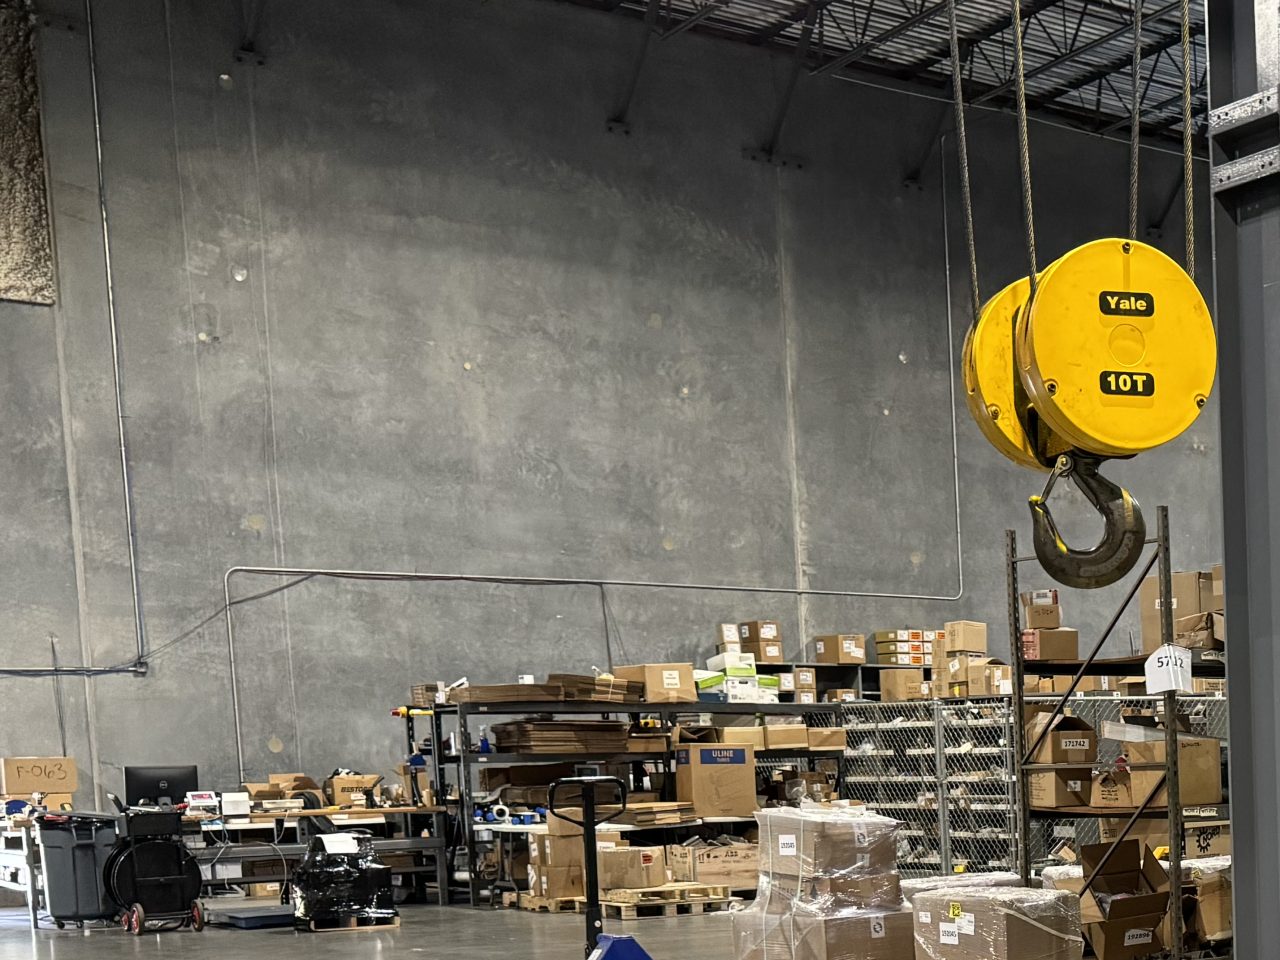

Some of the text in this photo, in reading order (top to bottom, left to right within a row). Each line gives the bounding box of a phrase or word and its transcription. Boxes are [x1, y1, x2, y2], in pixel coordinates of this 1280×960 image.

[1106, 296, 1147, 311] Yale
[1107, 374, 1147, 392] 10T
[712, 749, 734, 757] ULINE
[16, 762, 67, 780] F-063
